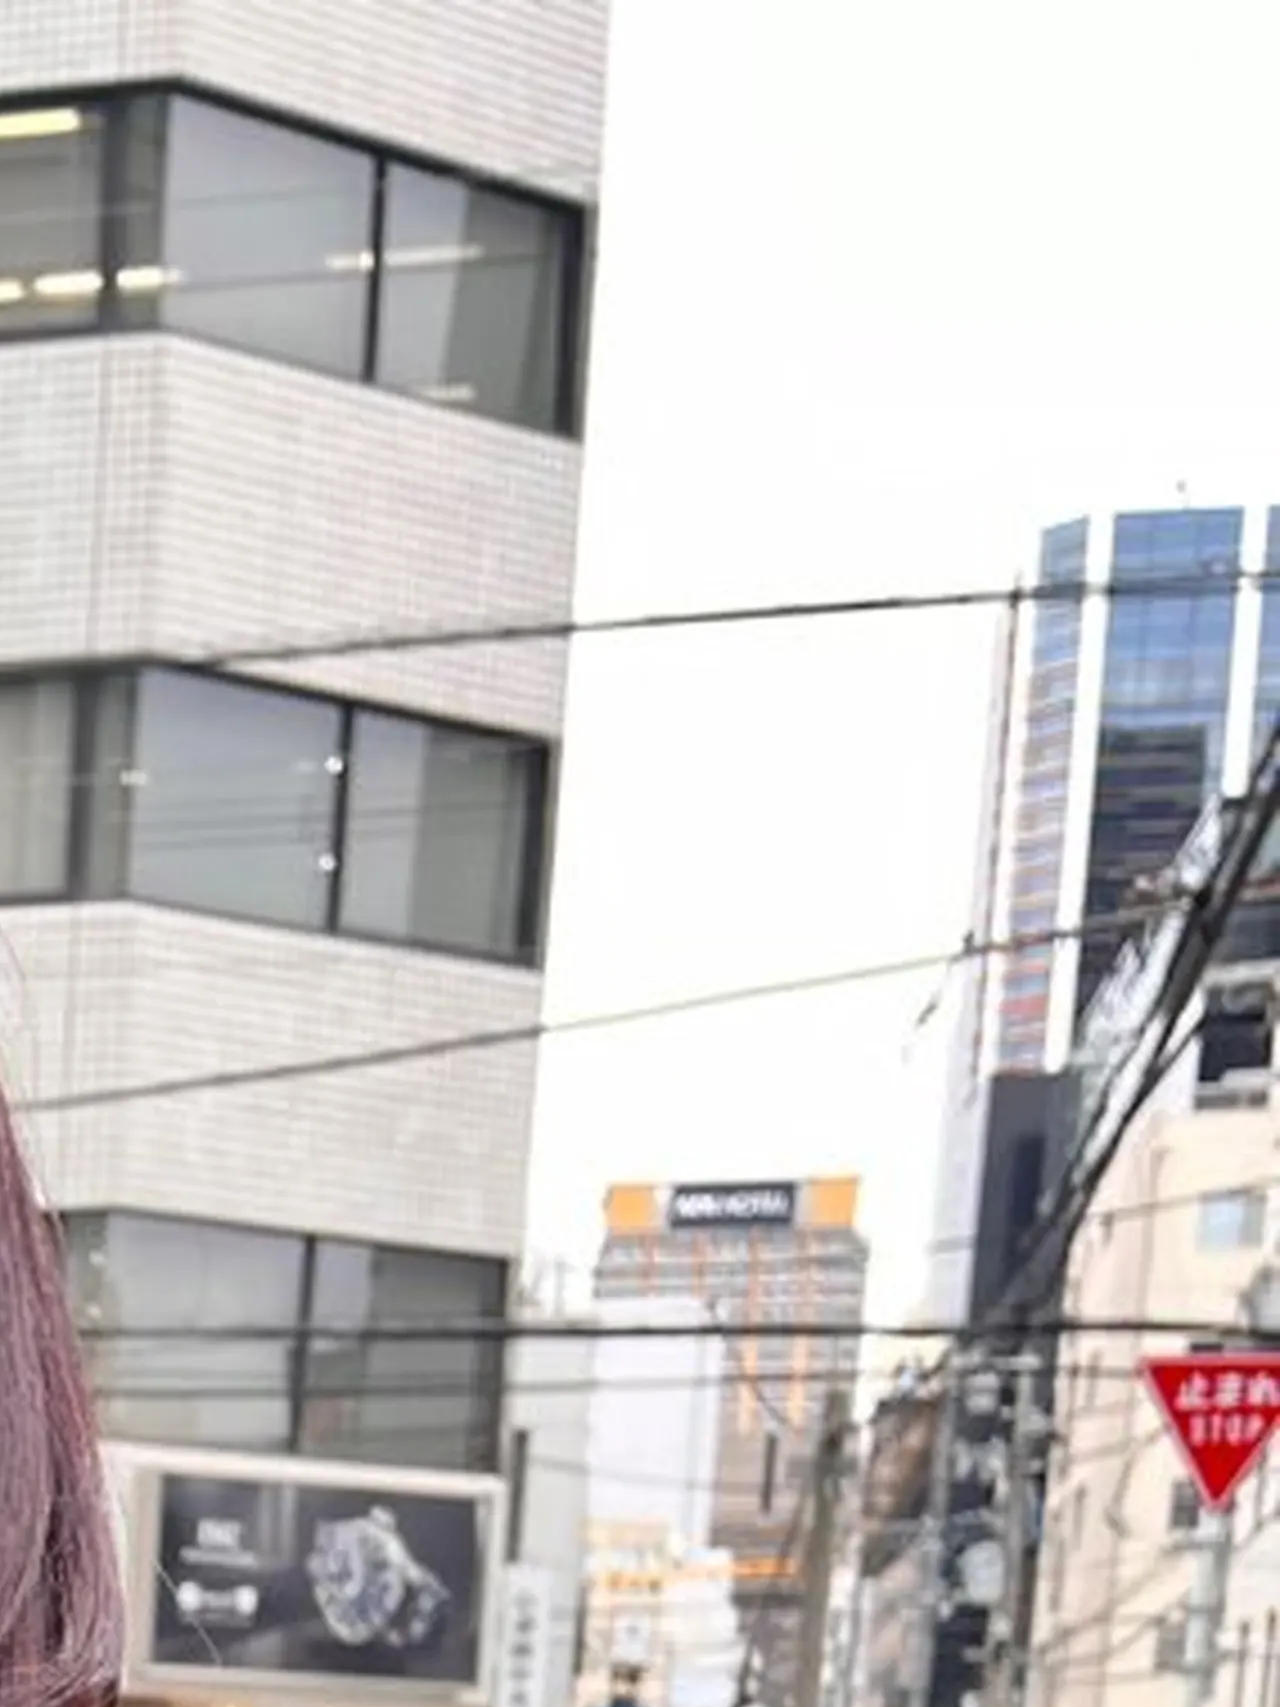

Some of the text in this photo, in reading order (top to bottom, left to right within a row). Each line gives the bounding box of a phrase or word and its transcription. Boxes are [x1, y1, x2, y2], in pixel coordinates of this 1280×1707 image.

[1173, 1369, 1280, 1411] 止まれ
[1189, 1411, 1266, 1446] STOP
